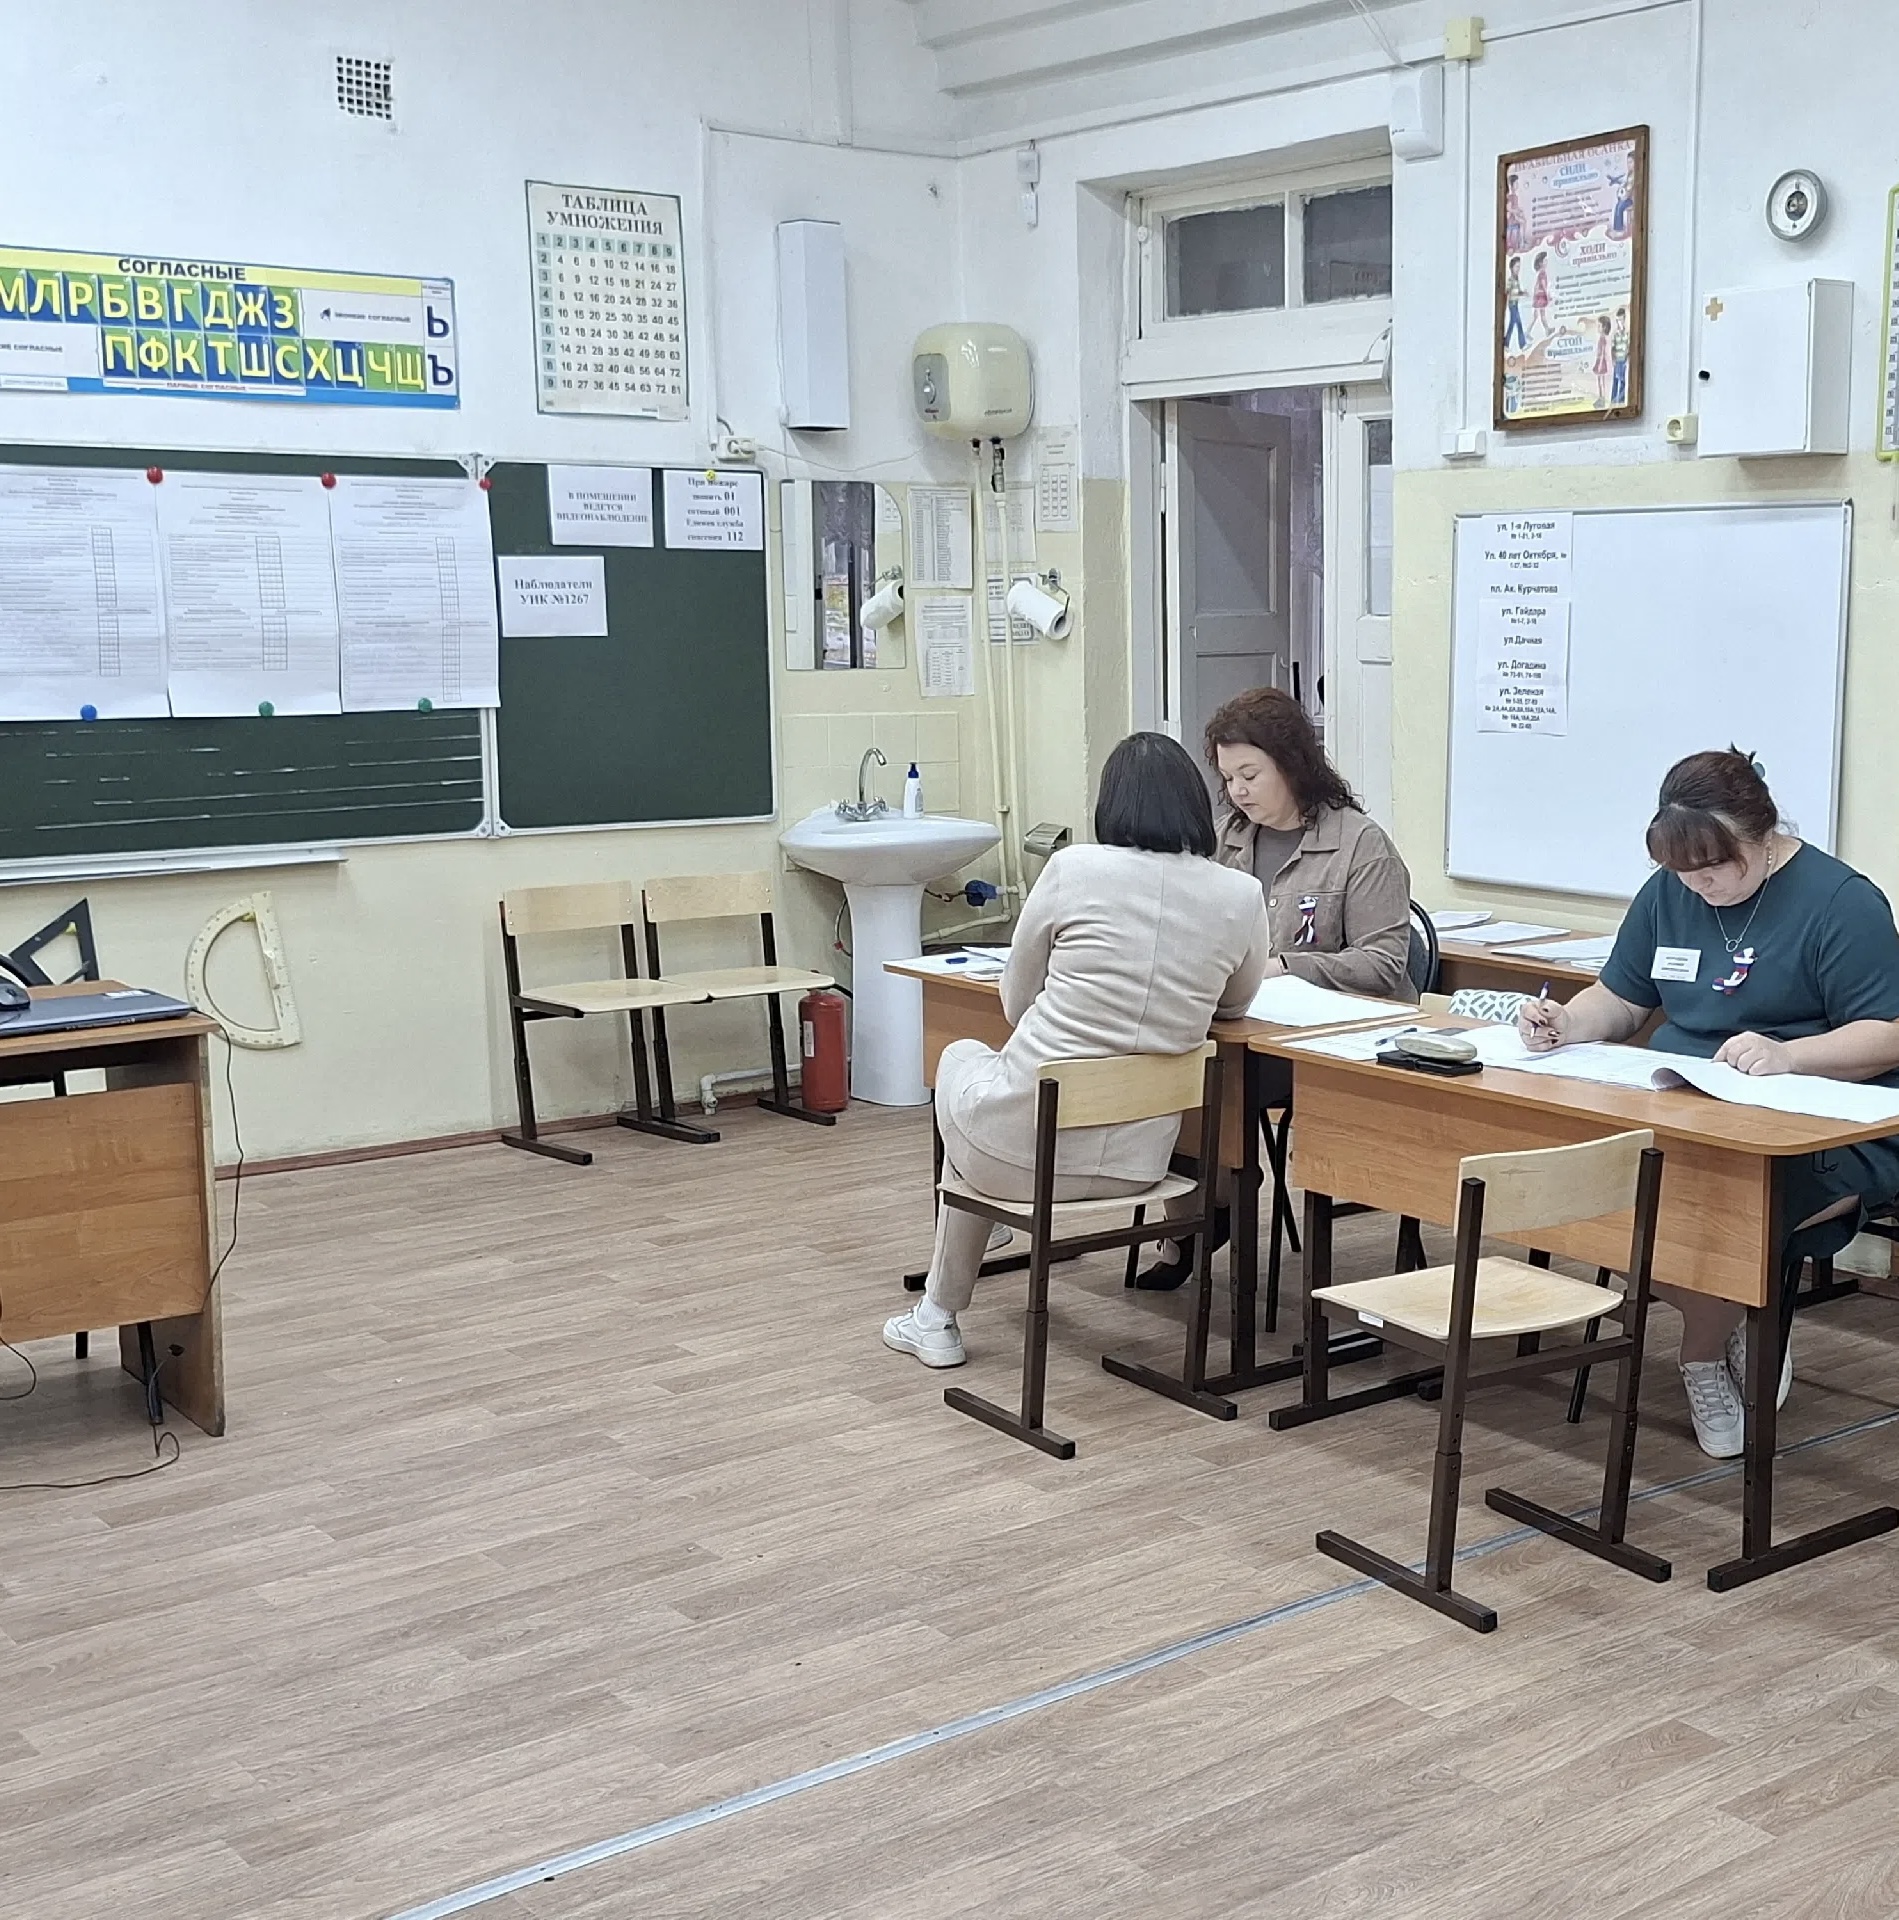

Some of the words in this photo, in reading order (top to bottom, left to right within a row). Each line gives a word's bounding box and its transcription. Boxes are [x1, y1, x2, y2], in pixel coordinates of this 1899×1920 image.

[1559, 163, 1587, 176] СИДИ
[561, 193, 648, 216] ТАБЛИЦА
[546, 211, 663, 236] УМНОЖЕНИЯ
[540, 235, 546, 246] 1
[556, 236, 563, 247] 2
[573, 238, 579, 249] 3
[588, 239, 595, 249] 4
[605, 240, 612, 251] 5
[635, 243, 643, 254] 7
[665, 247, 673, 257] 9
[1579, 243, 1606, 256] ХОДИ
[540, 252, 548, 264] 2
[557, 254, 564, 265] 4
[604, 260, 613, 268] 10
[620, 261, 629, 270] 12
[635, 262, 644, 270] 14
[118, 258, 247, 281] СОГЛАСНЫЕ
[541, 270, 548, 282] 3
[574, 274, 581, 284] 9
[589, 276, 599, 285] 12
[605, 277, 614, 286] 15
[636, 280, 644, 289] 21
[651, 281, 661, 289] 24
[667, 282, 676, 291] 27
[30, 279, 60, 315] Л
[69, 281, 93, 316] Р
[102, 283, 129, 318] Б
[137, 286, 163, 320] В
[174, 288, 193, 322] Г
[204, 291, 234, 329] Д
[236, 291, 268, 327] Ж
[542, 289, 549, 299] 4
[574, 292, 583, 301] 12
[605, 294, 615, 304] 20
[620, 296, 631, 305] 24
[652, 298, 662, 307] 32
[426, 305, 450, 338] Ь
[543, 306, 551, 317] 5
[558, 309, 568, 317] 10
[574, 310, 584, 319] 15
[590, 311, 600, 320] 20
[606, 312, 617, 321] 25
[622, 313, 633, 323] 30
[638, 314, 647, 323] 35
[652, 316, 663, 324] 40
[668, 317, 679, 325] 45
[560, 326, 569, 335] 12
[591, 329, 601, 337] 24
[607, 330, 618, 339] 30
[638, 332, 648, 340] 42
[669, 334, 679, 342] 54
[545, 342, 552, 353] 7
[560, 344, 571, 353] 14
[576, 345, 586, 354] 21
[608, 347, 619, 356] 35
[624, 348, 634, 357] 42
[640, 349, 650, 358] 49
[105, 335, 134, 370] П
[139, 336, 169, 373] Ф
[175, 338, 201, 374] К
[208, 340, 233, 375] Т
[239, 342, 270, 377] Ш
[275, 345, 300, 379] С
[306, 346, 332, 381] Х
[336, 348, 363, 388] Ц
[368, 351, 392, 384] Ч
[396, 352, 425, 390] Щ
[427, 354, 454, 386] Ъ
[577, 363, 588, 371] 24
[594, 364, 603, 372] 32
[608, 365, 619, 373] 40
[670, 368, 680, 377] 72
[547, 377, 554, 388] 9
[578, 380, 588, 388] 27
[609, 382, 619, 390] 45
[625, 383, 635, 391] 54
[656, 385, 666, 393] 72
[688, 477, 705, 488] При
[568, 492, 574, 500] В
[576, 492, 637, 501] ПОМЕЩЕНИИ
[724, 491, 735, 501] 01
[583, 503, 623, 511] ВЕДЕТСЯ
[724, 505, 740, 516] 001
[1497, 523, 1507, 533] ул.
[1523, 521, 1555, 532] Луговая
[727, 531, 744, 541] 112
[1484, 550, 1496, 560] Ул.
[1498, 550, 1507, 560] 40
[514, 579, 593, 589] Наблюдатели
[1517, 583, 1558, 595] Курчатова
[520, 594, 548, 605] УИК
[551, 594, 589, 605] №1267
[1501, 608, 1513, 617] ул.
[1515, 606, 1546, 618] Гайдара
[1497, 661, 1509, 670] ул.
[1511, 659, 1546, 670] Догадина
[1499, 688, 1511, 697] ул.
